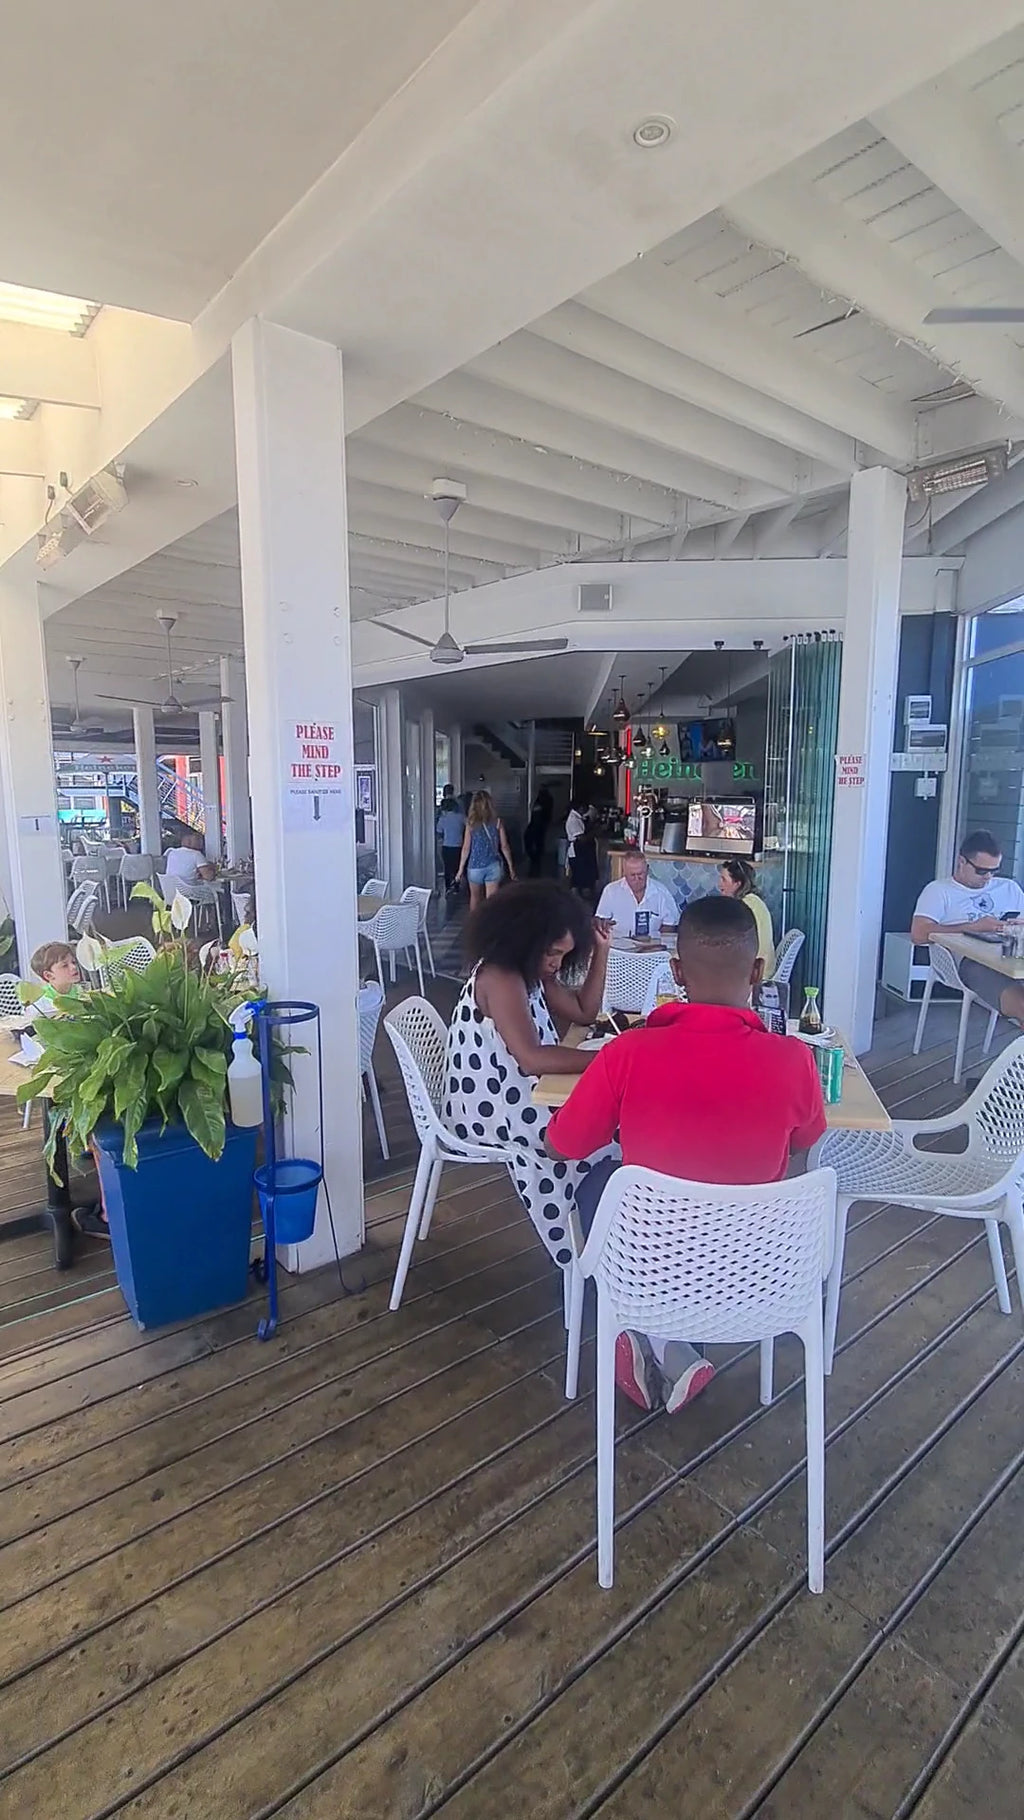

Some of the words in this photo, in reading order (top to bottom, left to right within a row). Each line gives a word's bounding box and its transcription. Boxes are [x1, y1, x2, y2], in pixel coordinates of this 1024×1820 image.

[296, 724, 334, 740] PLEASE
[302, 744, 329, 759] MIND
[840, 756, 862, 764] PLEASE
[291, 763, 312, 778] THE
[315, 764, 341, 778] STEP
[635, 757, 758, 781] Heinen
[842, 766, 858, 774] MIND
[837, 777, 847, 785] HE
[849, 777, 864, 785] STEP
